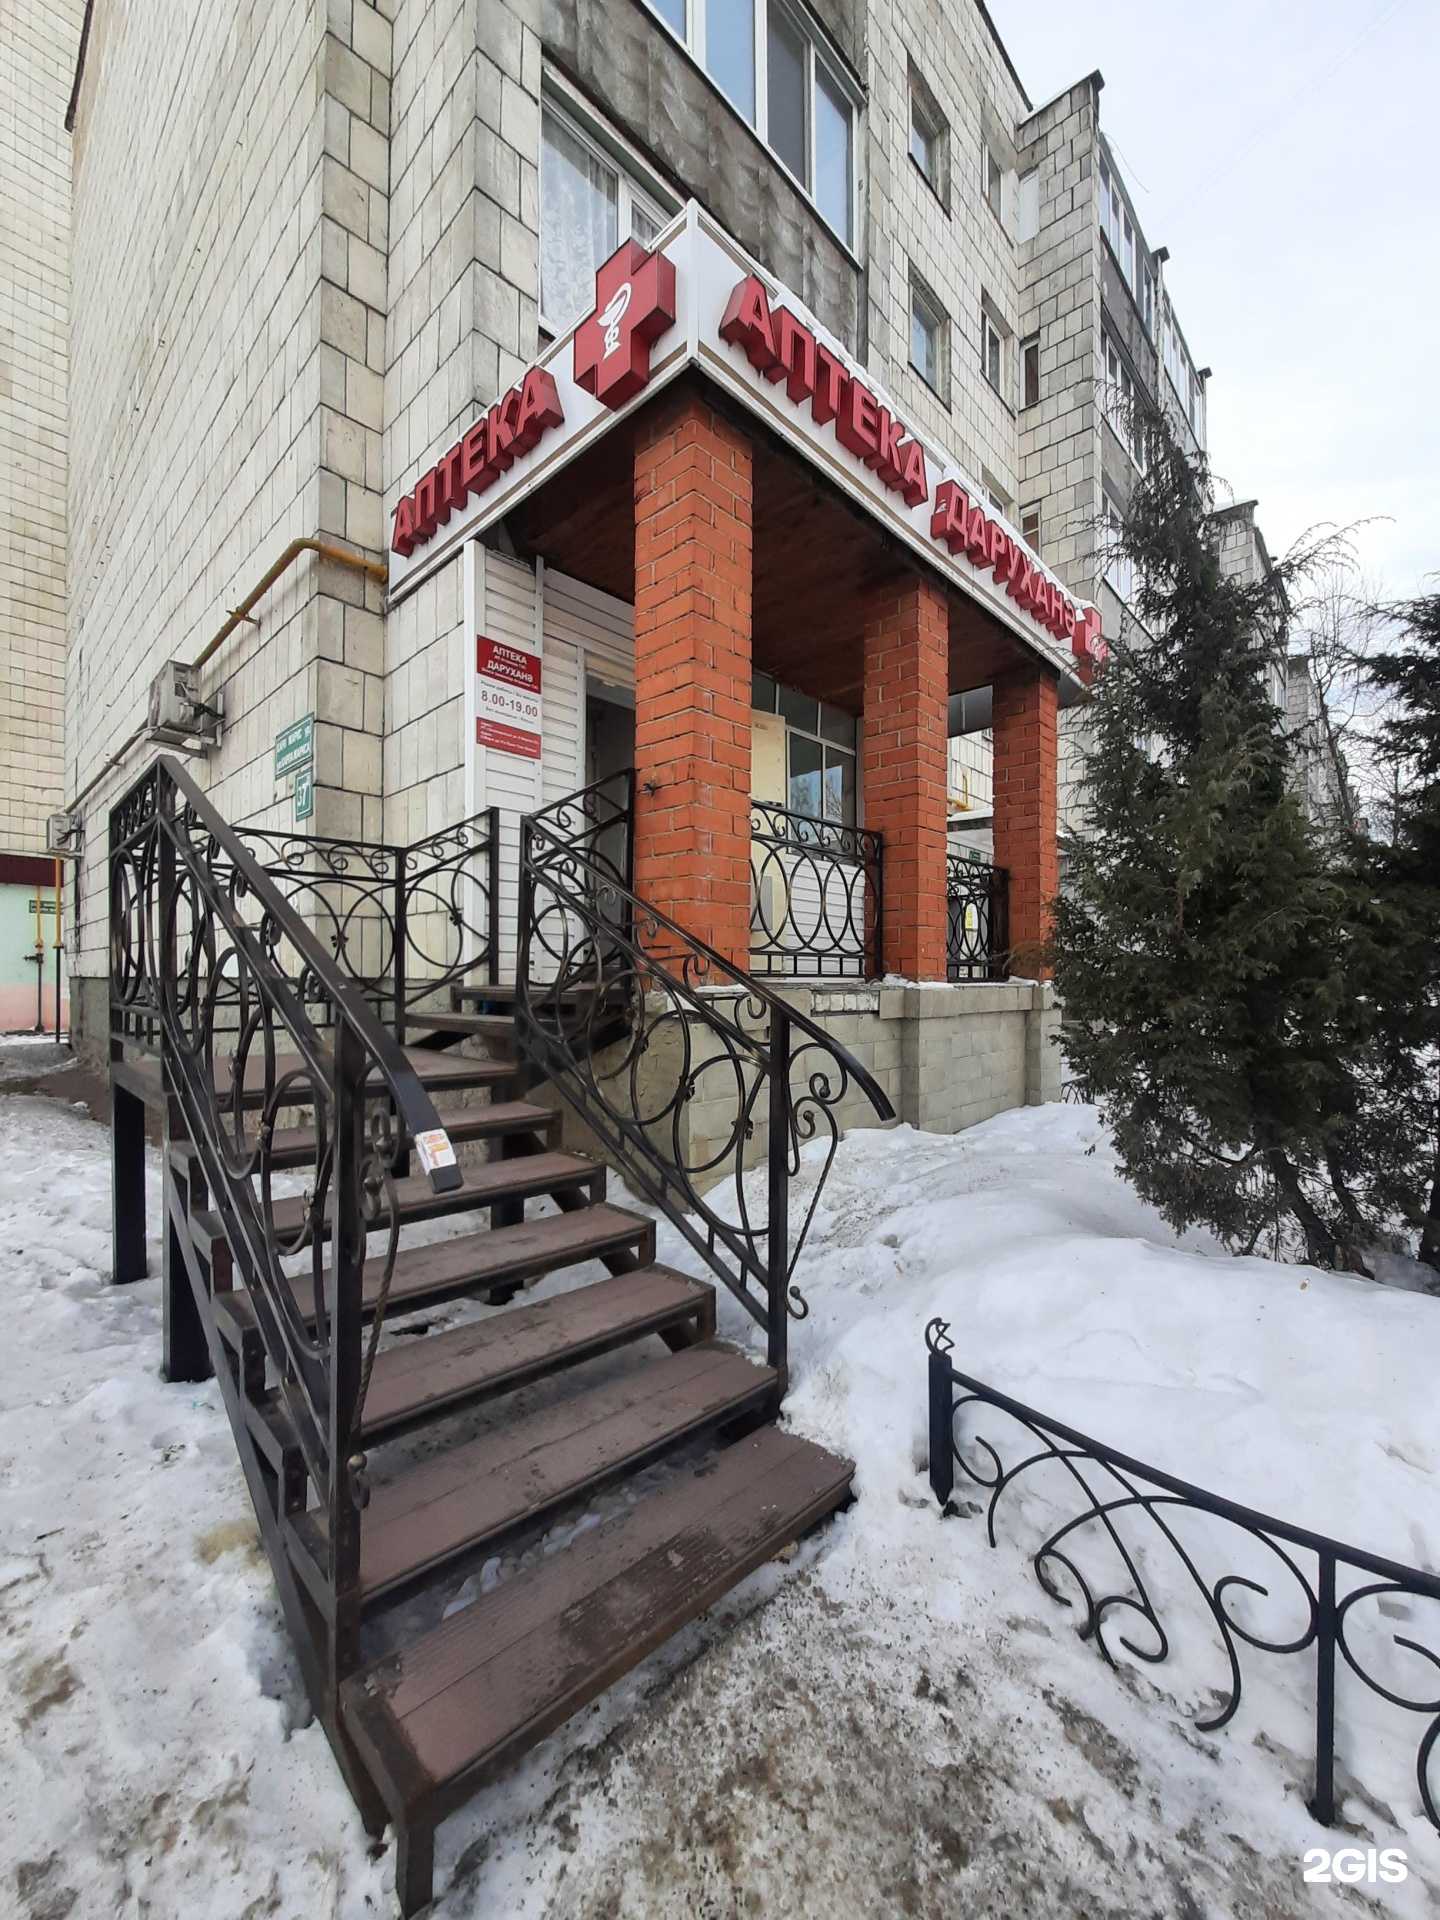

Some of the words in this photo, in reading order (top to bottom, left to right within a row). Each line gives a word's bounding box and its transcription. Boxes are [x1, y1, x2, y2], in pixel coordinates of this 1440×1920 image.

[718, 273, 928, 509] АПТЕКА
[391, 365, 565, 558] АПТЕКА
[481, 690, 538, 717] 8.00-19.00
[492, 645, 528, 665] АПТЕКА
